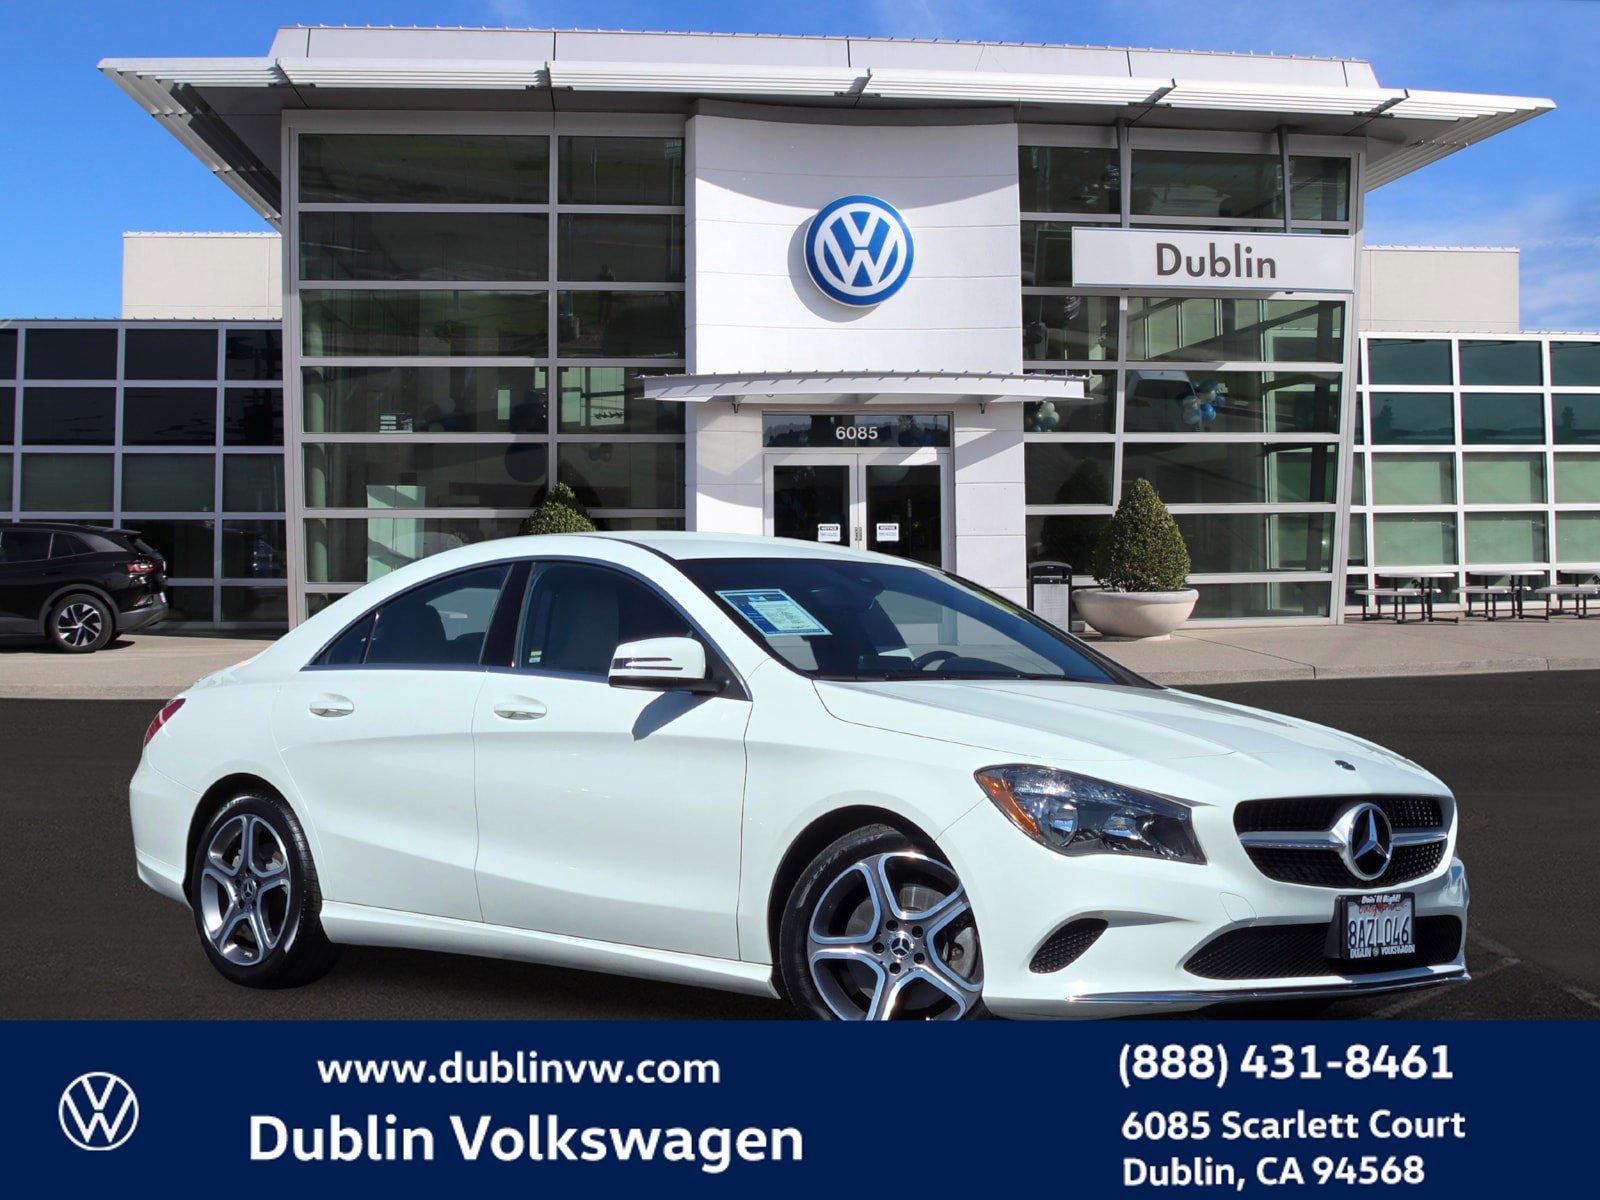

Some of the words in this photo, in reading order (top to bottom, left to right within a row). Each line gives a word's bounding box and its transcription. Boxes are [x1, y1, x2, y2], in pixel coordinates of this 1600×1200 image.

[1156, 242, 1276, 279] Dublin
[835, 426, 878, 440] 6085
[1349, 916, 1410, 948] 8AZL046
[1350, 948, 1371, 959] DUBLIN
